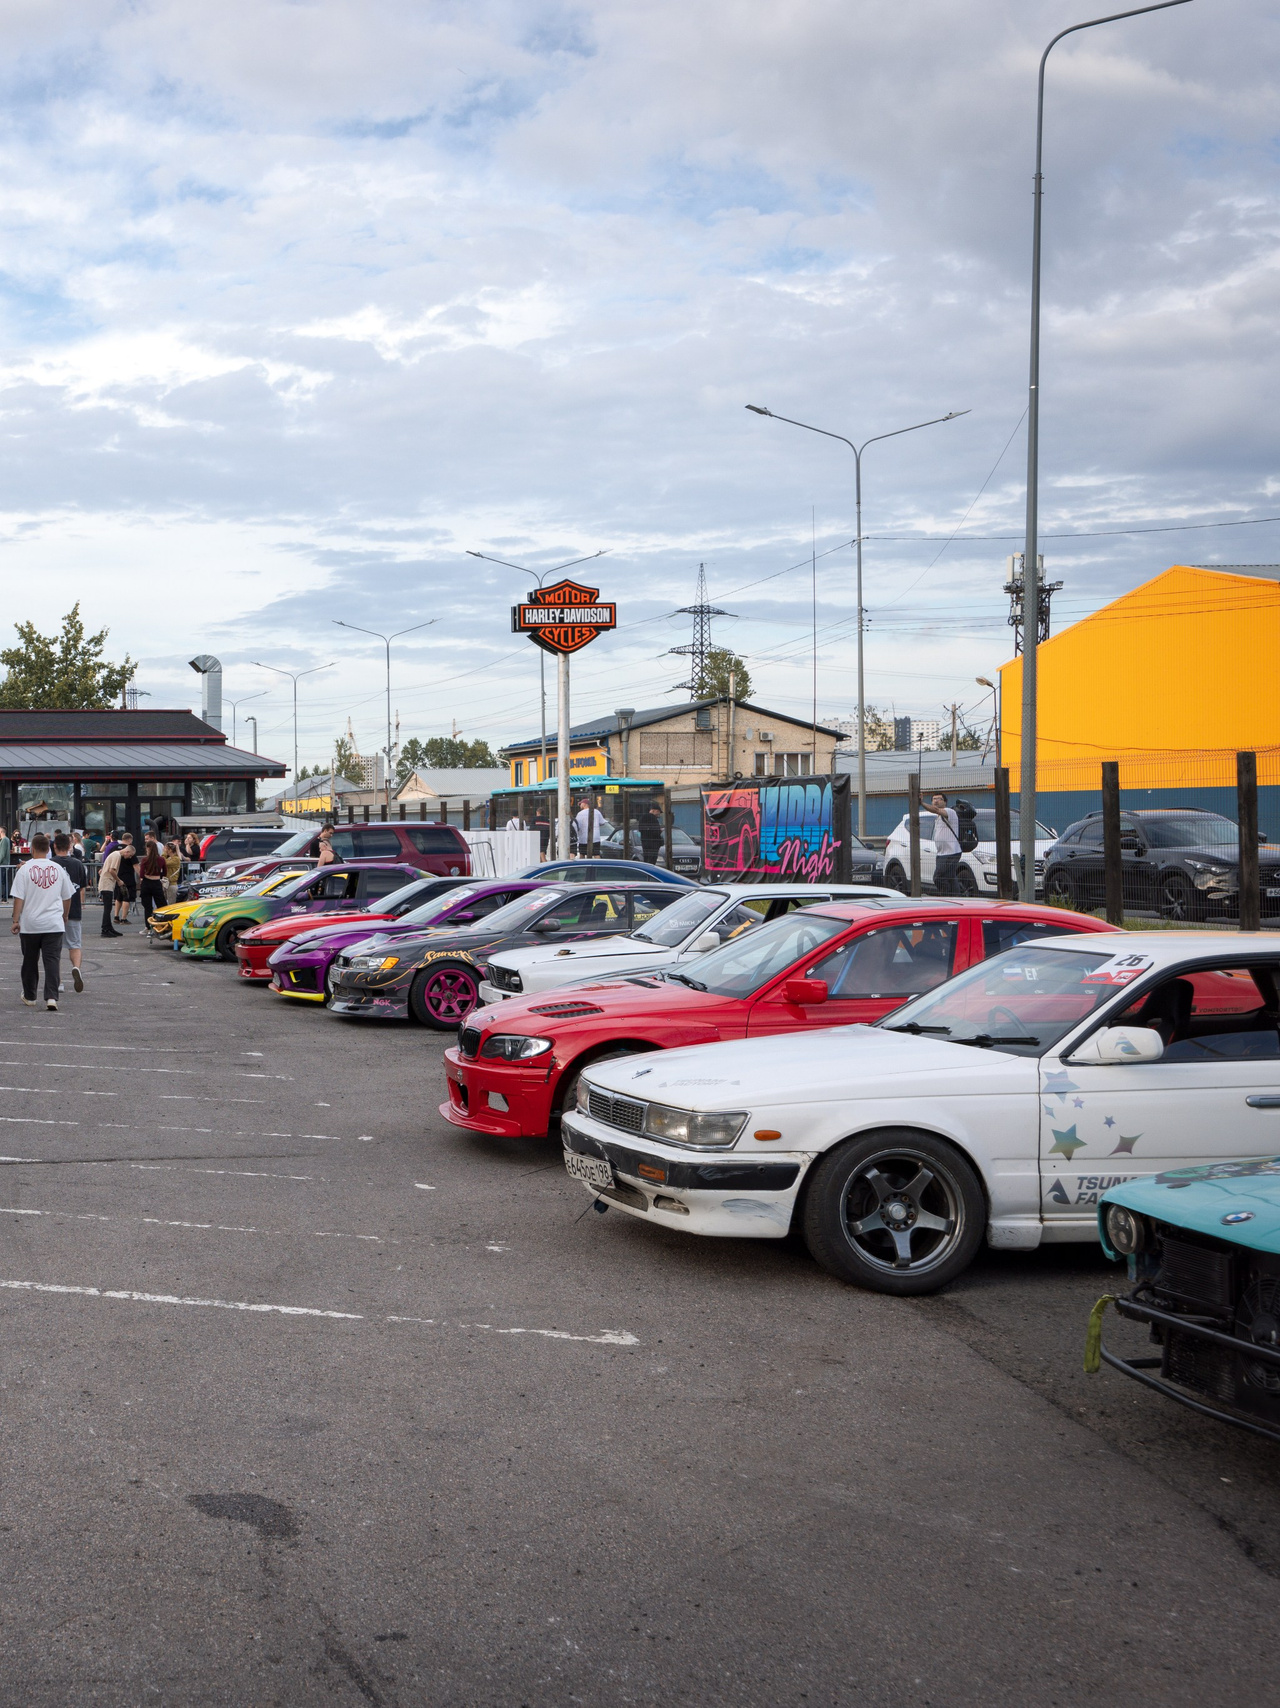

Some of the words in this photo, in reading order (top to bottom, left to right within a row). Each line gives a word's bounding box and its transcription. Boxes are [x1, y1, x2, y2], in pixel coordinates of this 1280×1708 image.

[545, 587, 589, 604] MOTOR
[525, 608, 610, 624] HARLEY-DAVIDSON
[545, 627, 590, 647] CYCLES
[1114, 954, 1149, 966] 26
[373, 998, 391, 1006] NGK
[1077, 1176, 1138, 1190] TSUN
[1074, 1192, 1104, 1205] FA
